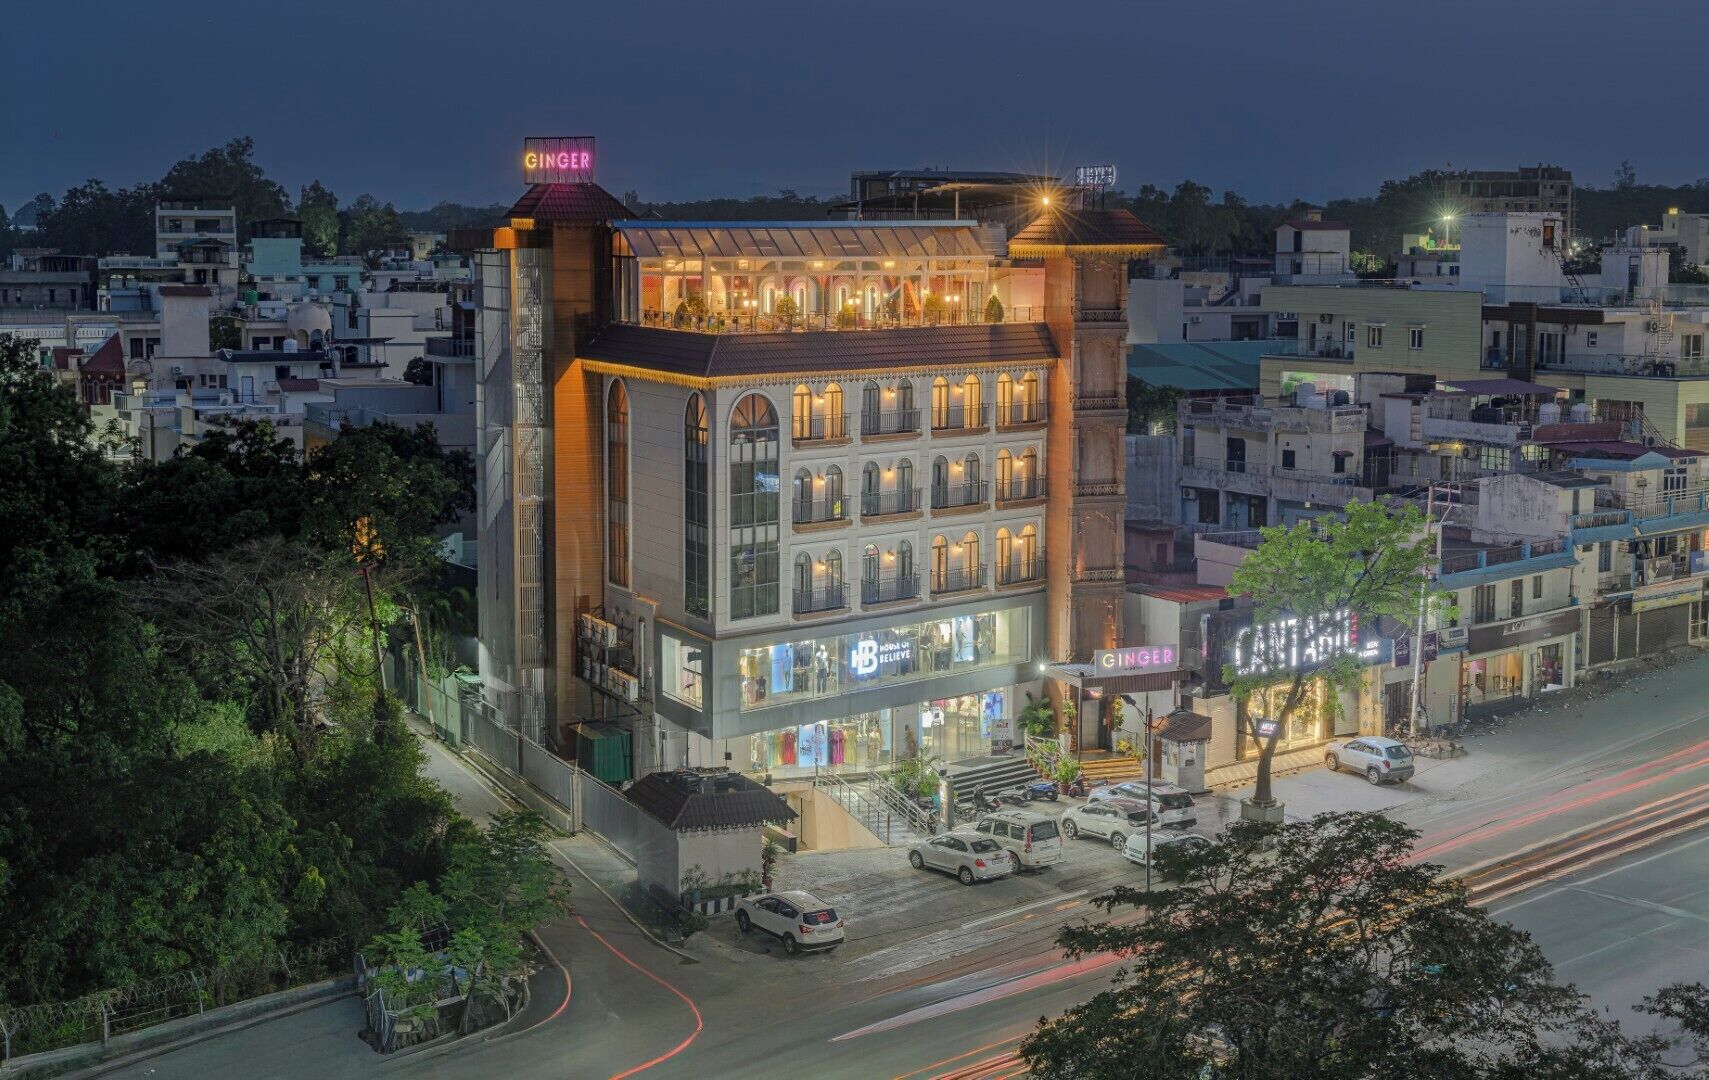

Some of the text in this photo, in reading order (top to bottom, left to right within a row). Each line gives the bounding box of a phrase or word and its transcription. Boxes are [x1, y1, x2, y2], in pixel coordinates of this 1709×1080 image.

[525, 152, 590, 169] GINGER
[879, 649, 911, 664] BELIEVE
[1102, 648, 1173, 668] GINGER
